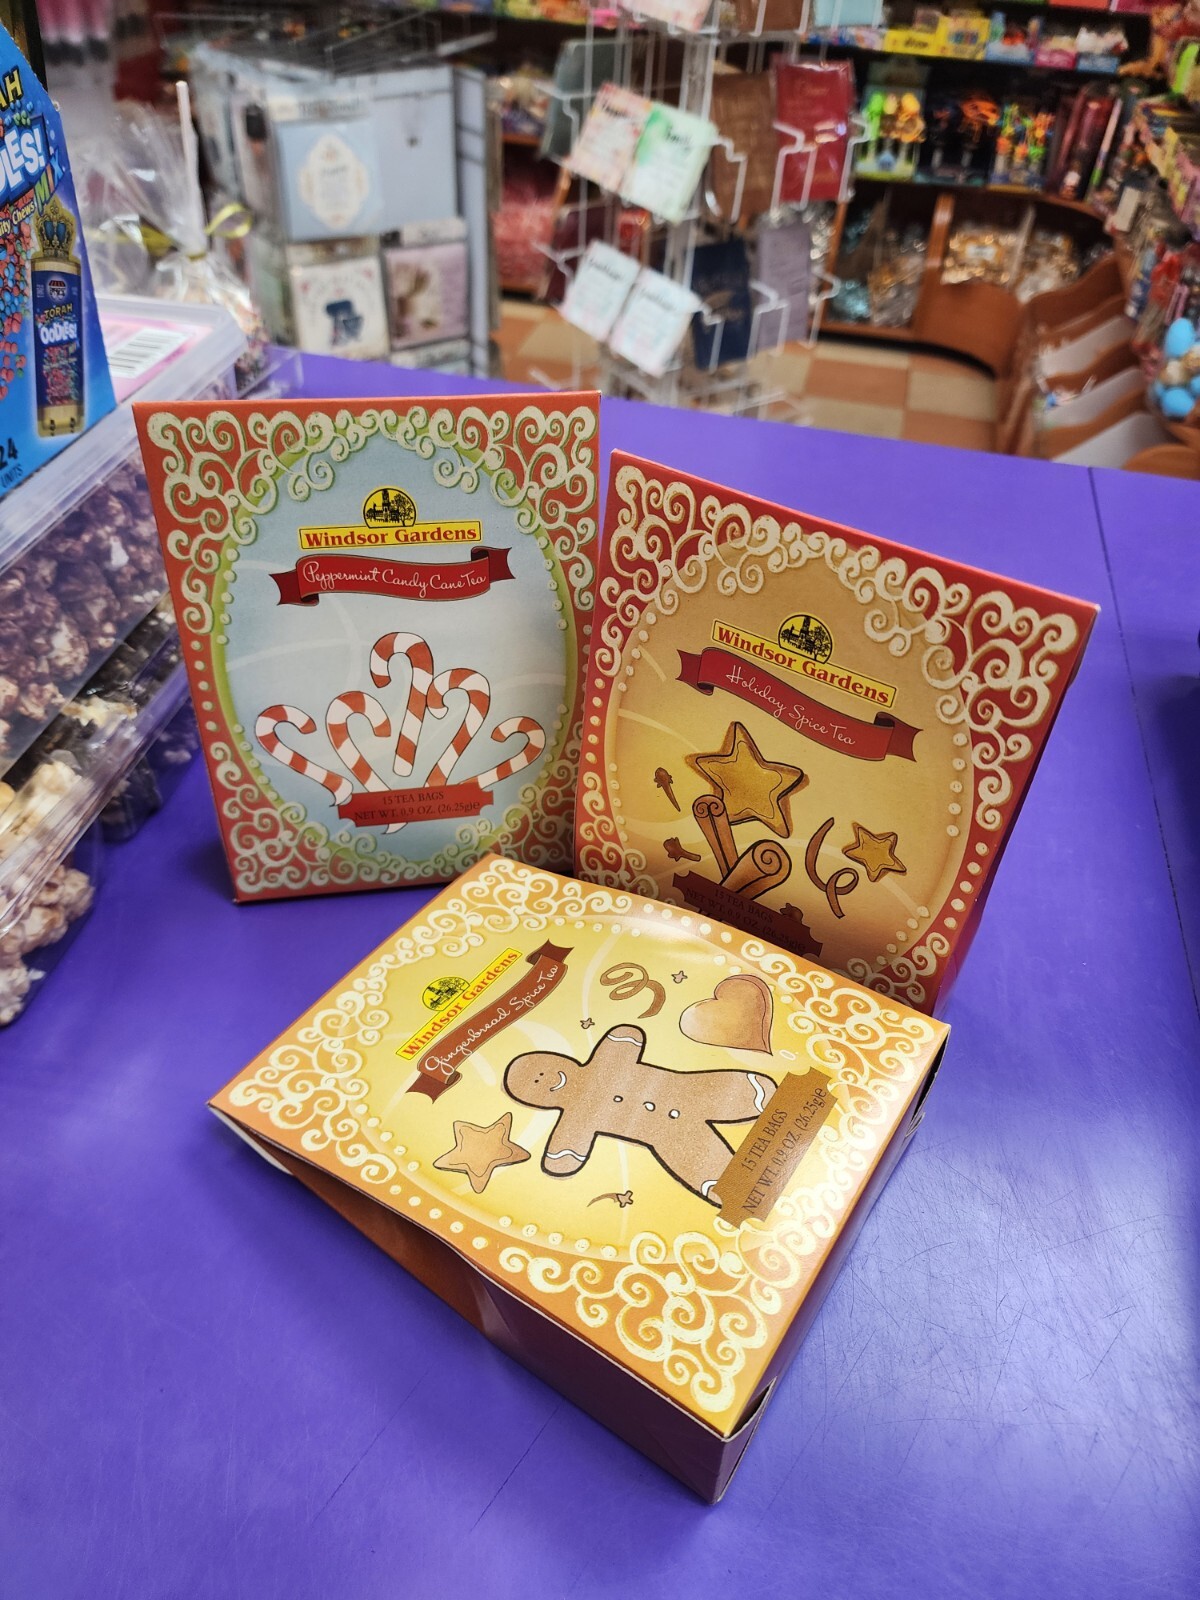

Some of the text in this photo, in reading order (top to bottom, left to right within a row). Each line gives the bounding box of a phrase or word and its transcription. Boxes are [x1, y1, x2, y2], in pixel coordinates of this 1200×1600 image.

[34, 149, 63, 215] MIX
[12, 201, 35, 225] Chews
[44, 303, 73, 319] TORAH
[0, 437, 18, 470] 24
[0, 463, 23, 488] UNITS
[305, 526, 477, 547] Windsor Gardens
[303, 560, 487, 598] Peppermint Candy Cane Tea
[718, 626, 889, 704] Windsor Gardens
[726, 664, 856, 745] Holiday Spice Tea
[354, 810, 378, 821] NET
[378, 808, 398, 819] WT.
[400, 807, 414, 817] 0.9
[417, 805, 436, 815] OZ.
[383, 791, 444, 805] 15 TEA BAGS
[686, 888, 705, 902] NET
[728, 909, 740, 920] 0.9
[714, 889, 773, 923] 15 TEA BAGS
[402, 952, 518, 1056] Windsor Gardens
[424, 964, 559, 1076] Gingerbread Spice Tea
[741, 1108, 788, 1172] 15 TEA BAGS
[742, 1187, 766, 1214] NET
[757, 1168, 779, 1188] WT.
[772, 1149, 789, 1167] 0.9
[782, 1131, 801, 1153] OZ.
